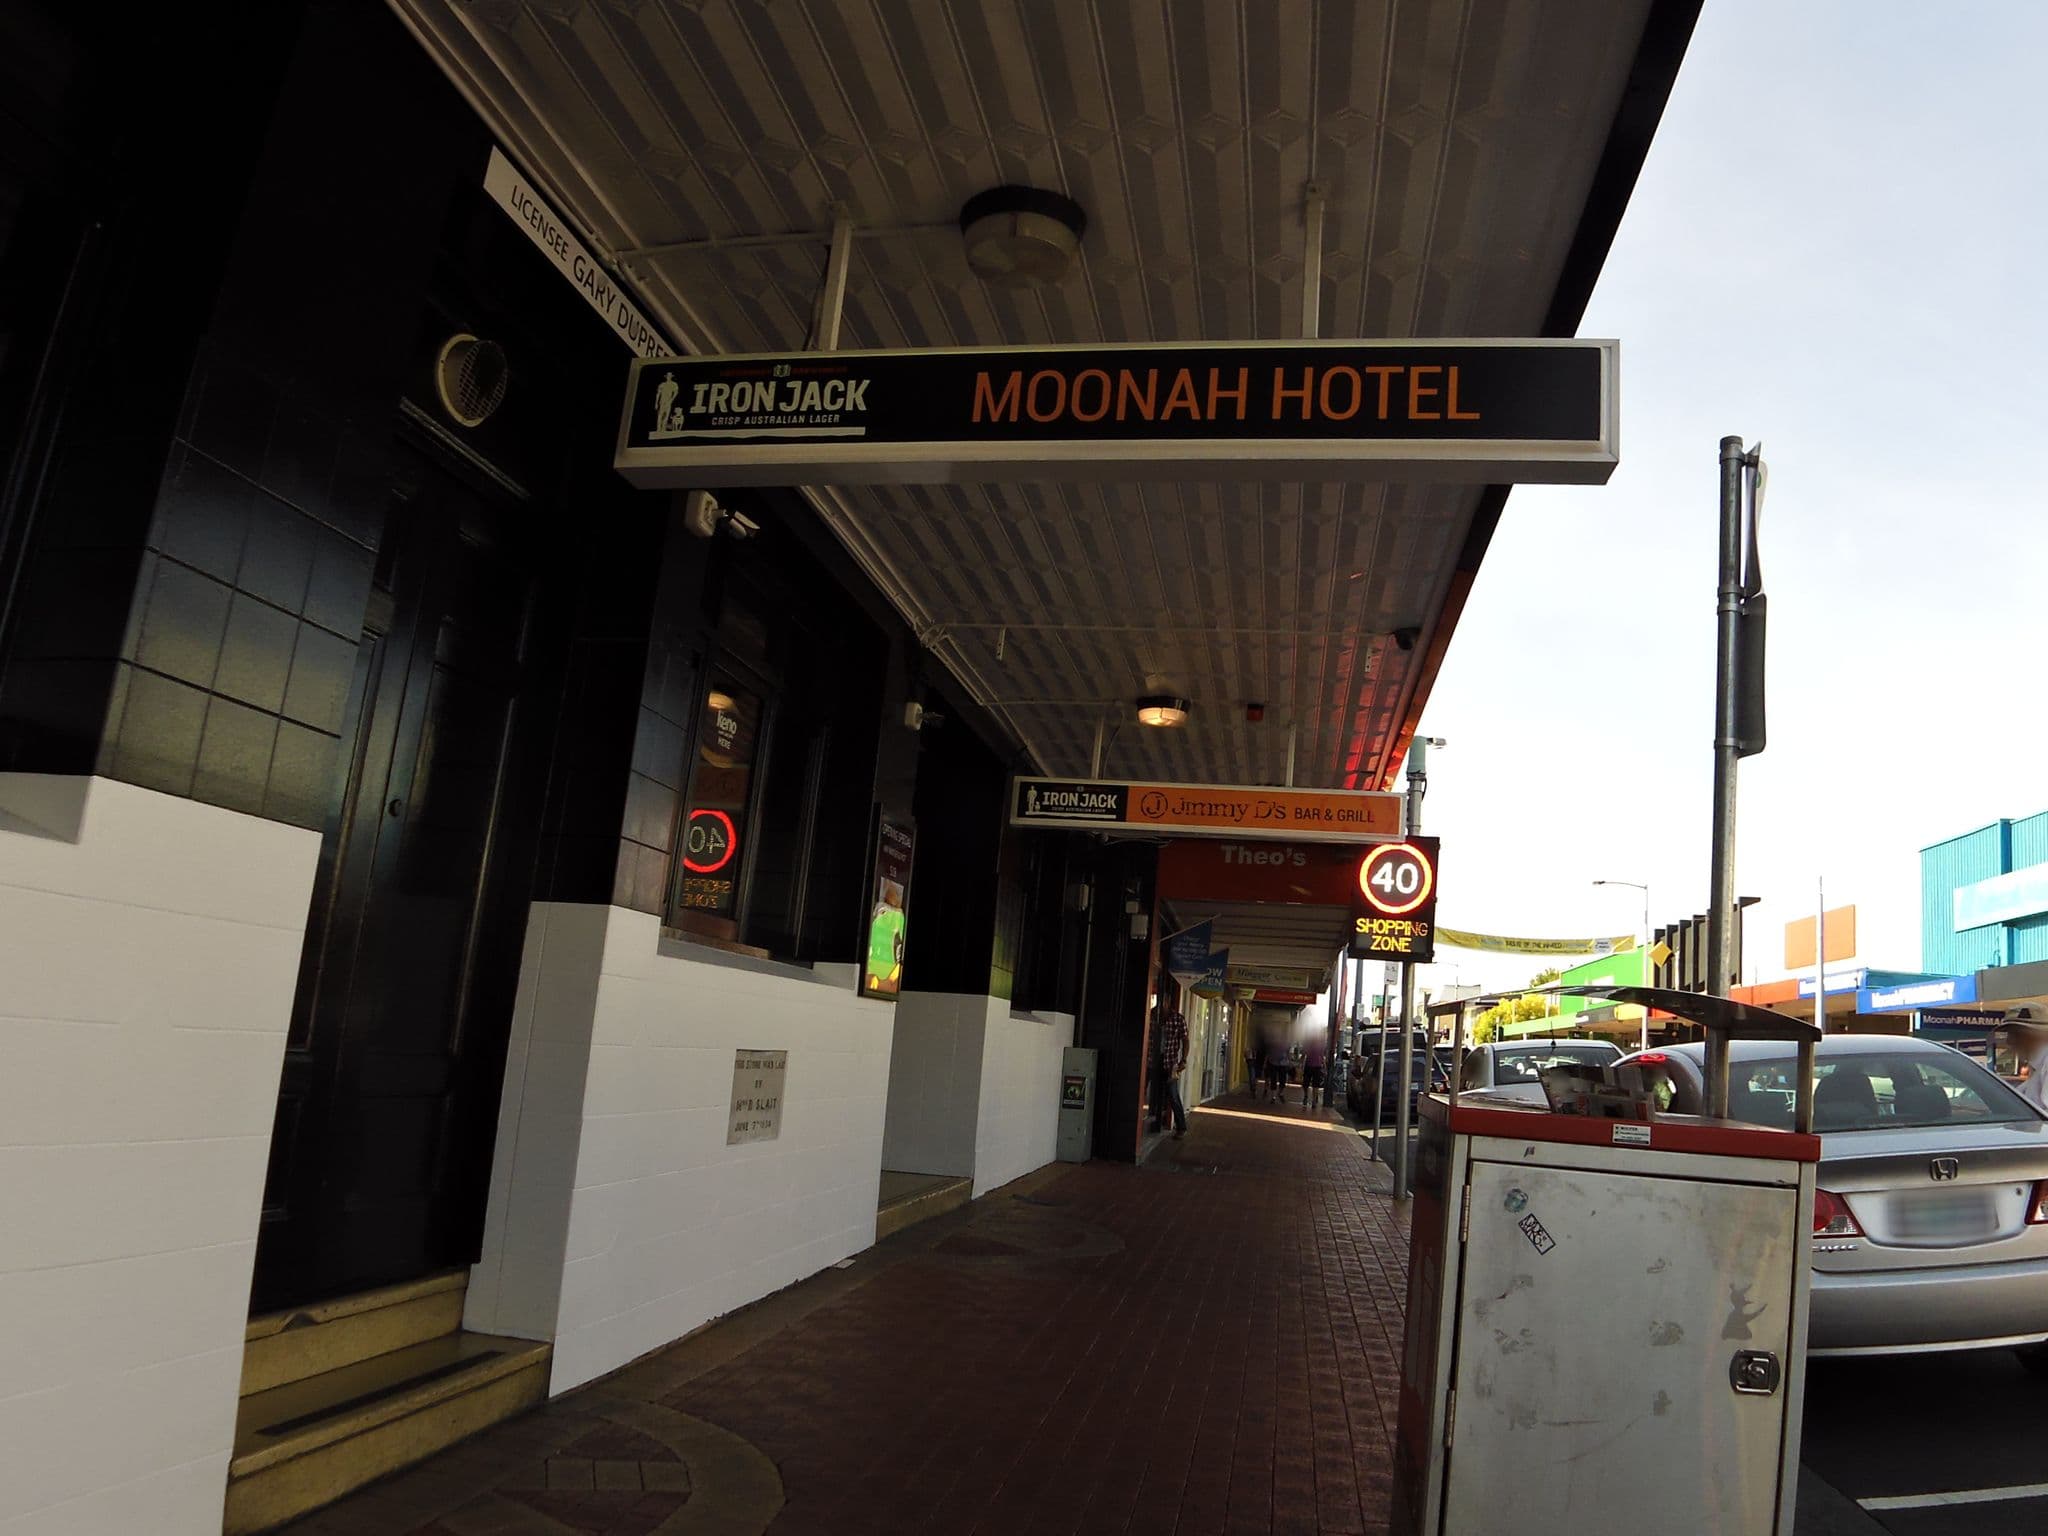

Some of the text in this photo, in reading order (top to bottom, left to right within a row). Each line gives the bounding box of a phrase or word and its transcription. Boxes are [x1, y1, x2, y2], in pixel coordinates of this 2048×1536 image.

[511, 184, 671, 358] LICENSEE GARY DUPRE
[689, 379, 871, 413] IRON JACK
[970, 365, 1481, 423] MOONAH HOTEL
[711, 413, 840, 426] CRISP AUSTRALIAN LAGER
[1041, 791, 1079, 807] IRON
[1080, 793, 1119, 809] JACK
[1171, 797, 1249, 823] Jimmy
[1254, 800, 1287, 821] D's
[1295, 808, 1321, 821] BAR
[1324, 809, 1334, 821] &
[1338, 809, 1375, 824] GRILL
[1221, 844, 1307, 867] Theo's
[1370, 861, 1419, 895] 40
[1355, 917, 1429, 937] SHOPPING
[1369, 935, 1413, 953] ZONE
